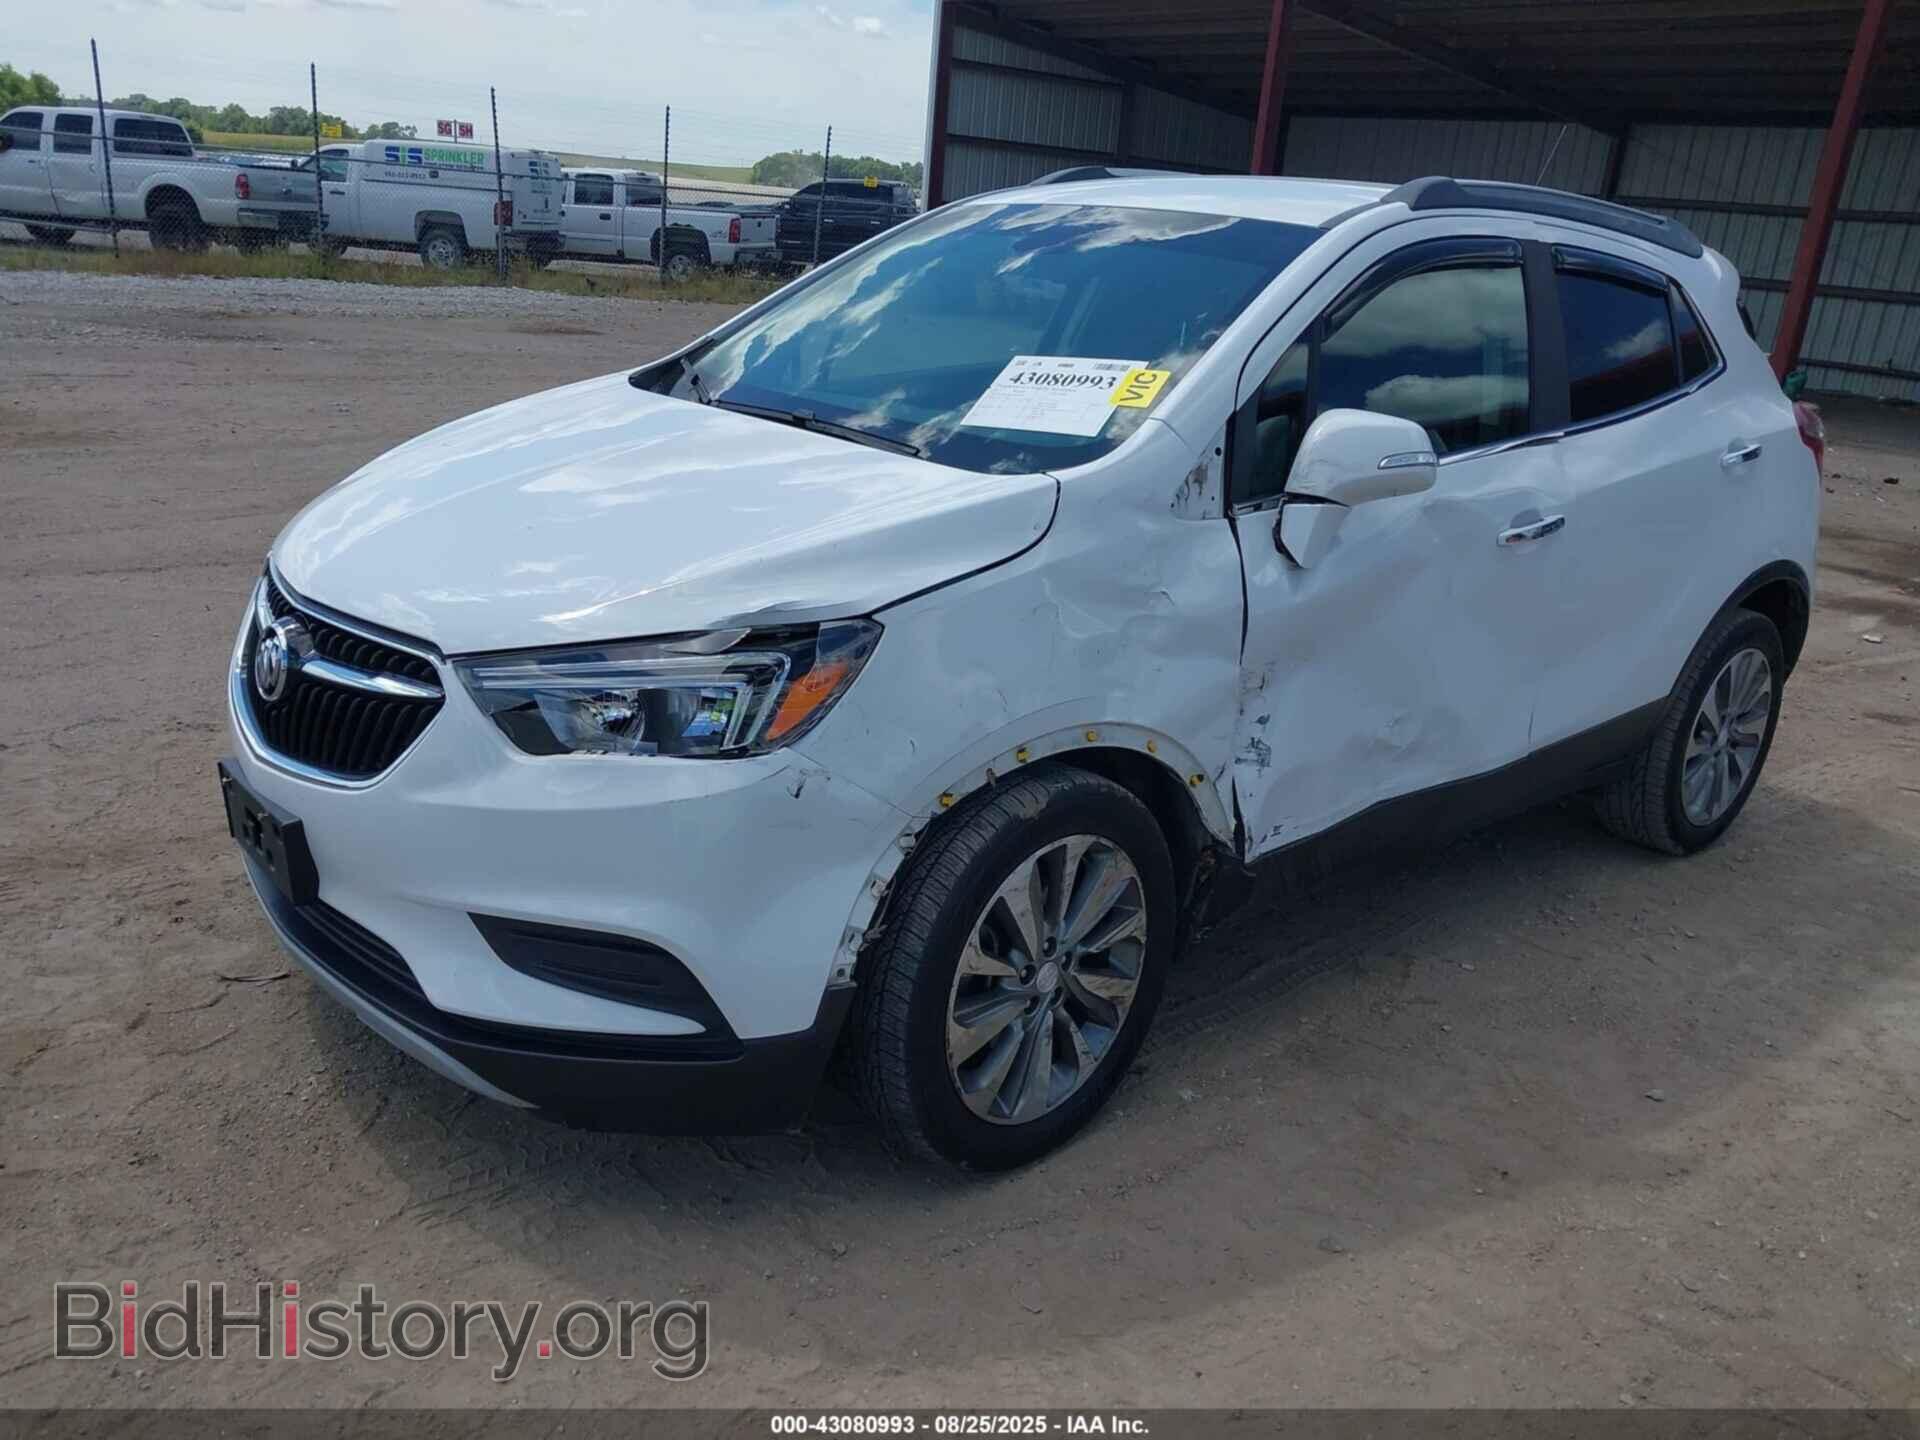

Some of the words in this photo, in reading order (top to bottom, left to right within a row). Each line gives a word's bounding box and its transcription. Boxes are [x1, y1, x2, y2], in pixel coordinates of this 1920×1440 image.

[423, 148, 485, 166] SPRINKLER
[1009, 371, 1117, 390] 43080993
[1119, 372, 1157, 402] VIC
